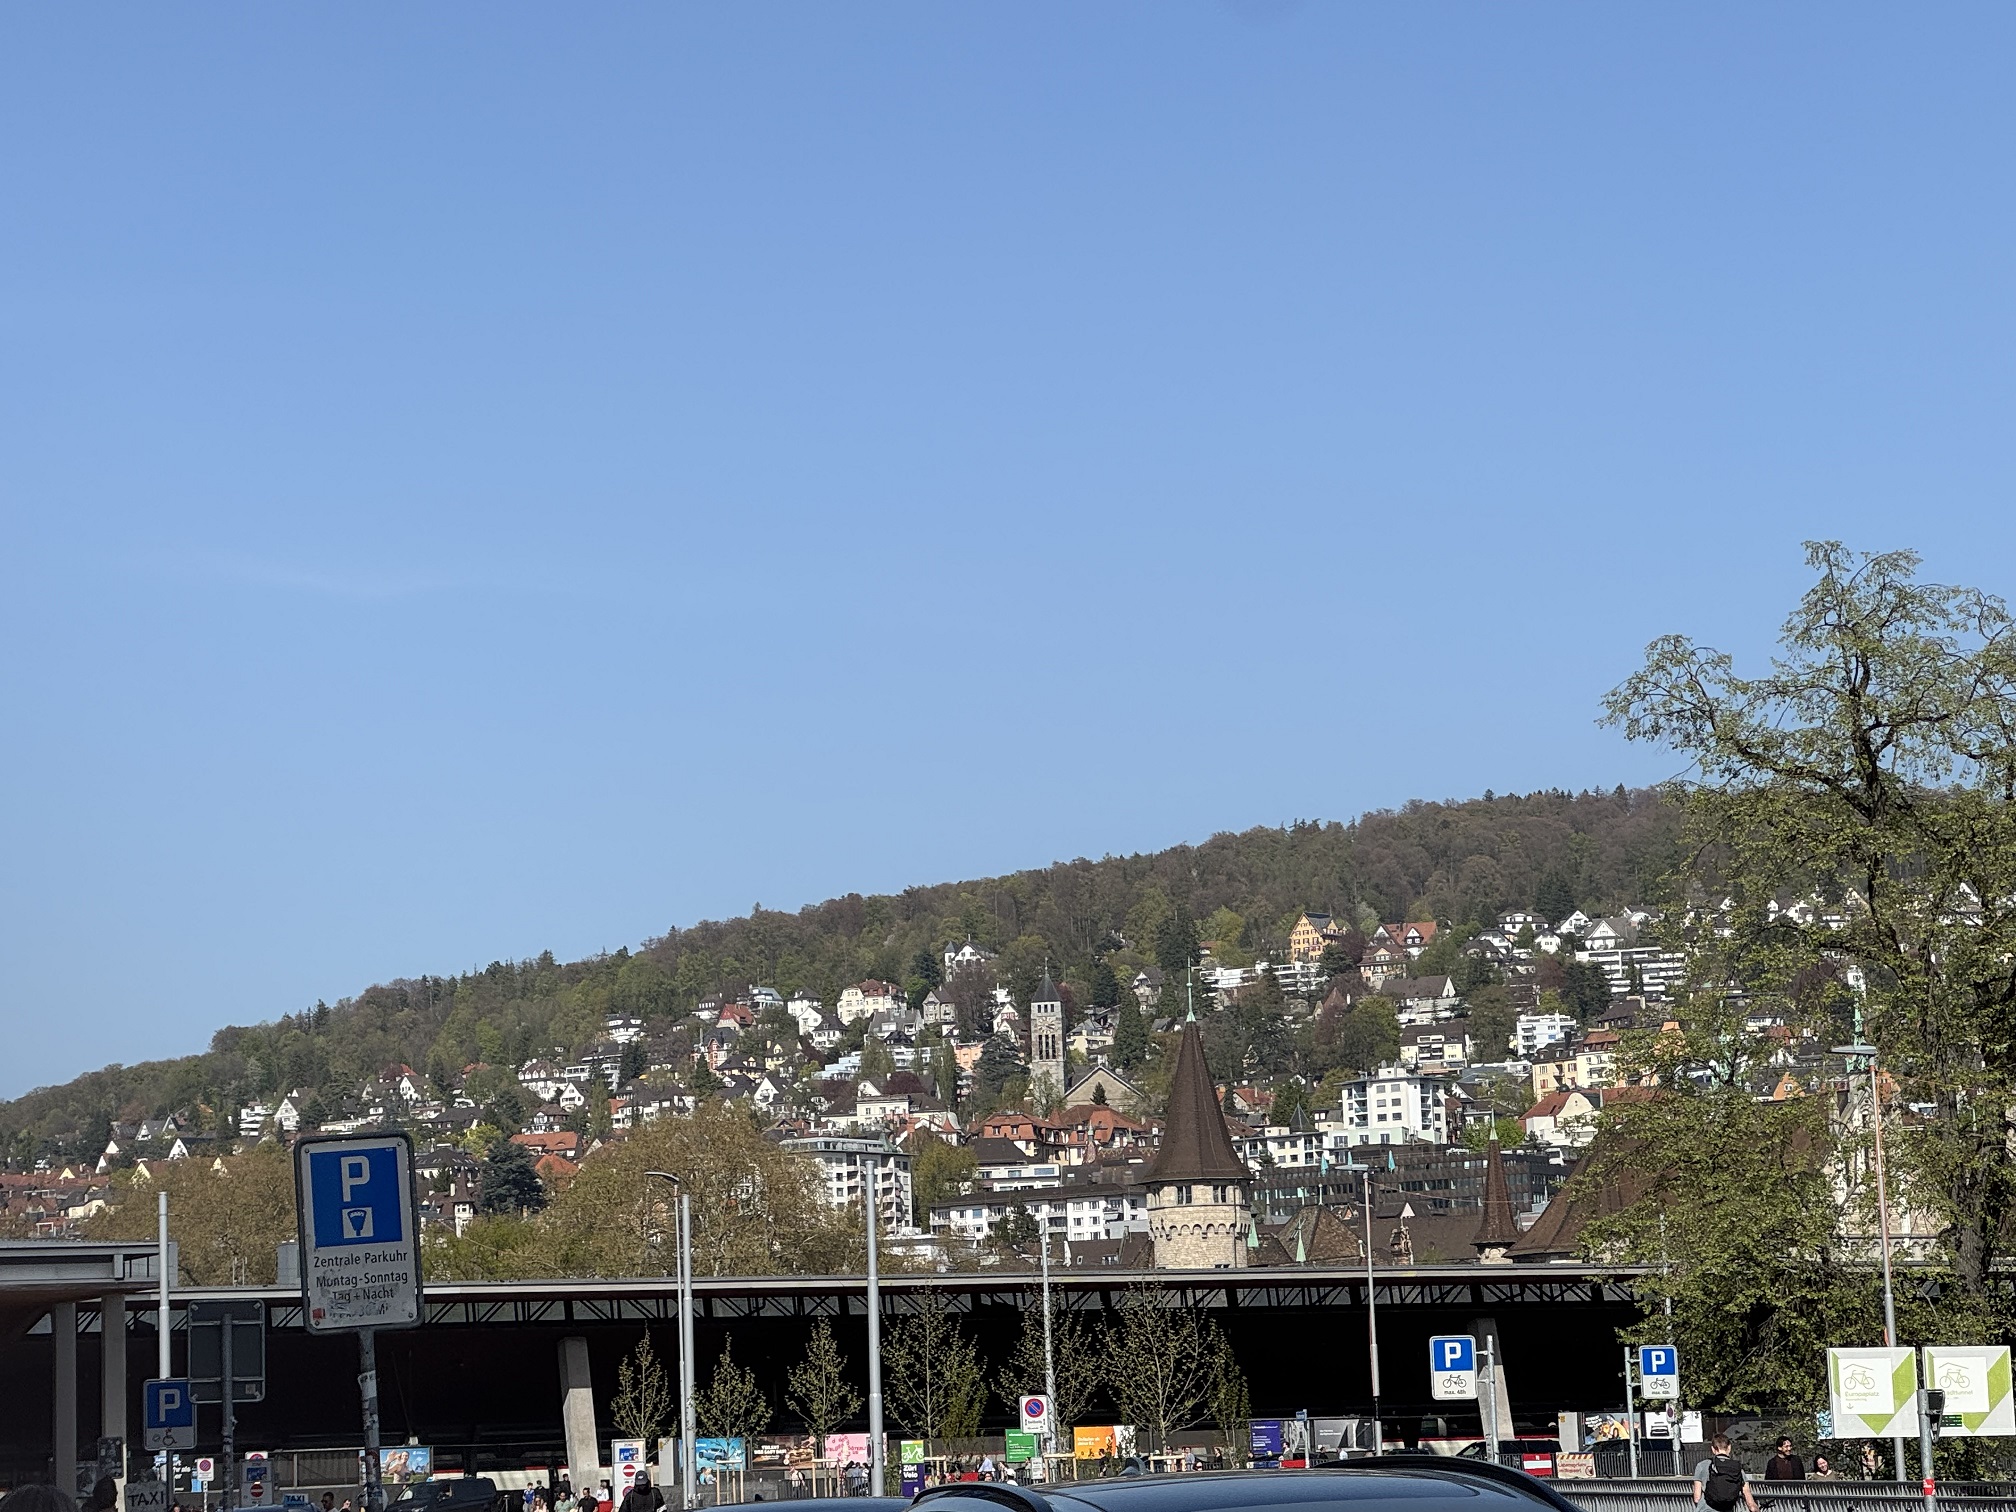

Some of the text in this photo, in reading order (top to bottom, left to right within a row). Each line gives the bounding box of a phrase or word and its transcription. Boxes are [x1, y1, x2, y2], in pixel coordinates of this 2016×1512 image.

[341, 1155, 371, 1203] P
[314, 1249, 408, 1268] Zentrale Parkuhr
[332, 1290, 351, 1304] Tag
[363, 1287, 394, 1300] Nacht
[1444, 1342, 1462, 1368] P
[1651, 1350, 1666, 1373] P
[159, 1388, 181, 1422] P
[127, 1491, 164, 1507] TAXI
[285, 1494, 305, 1502] TAXI
